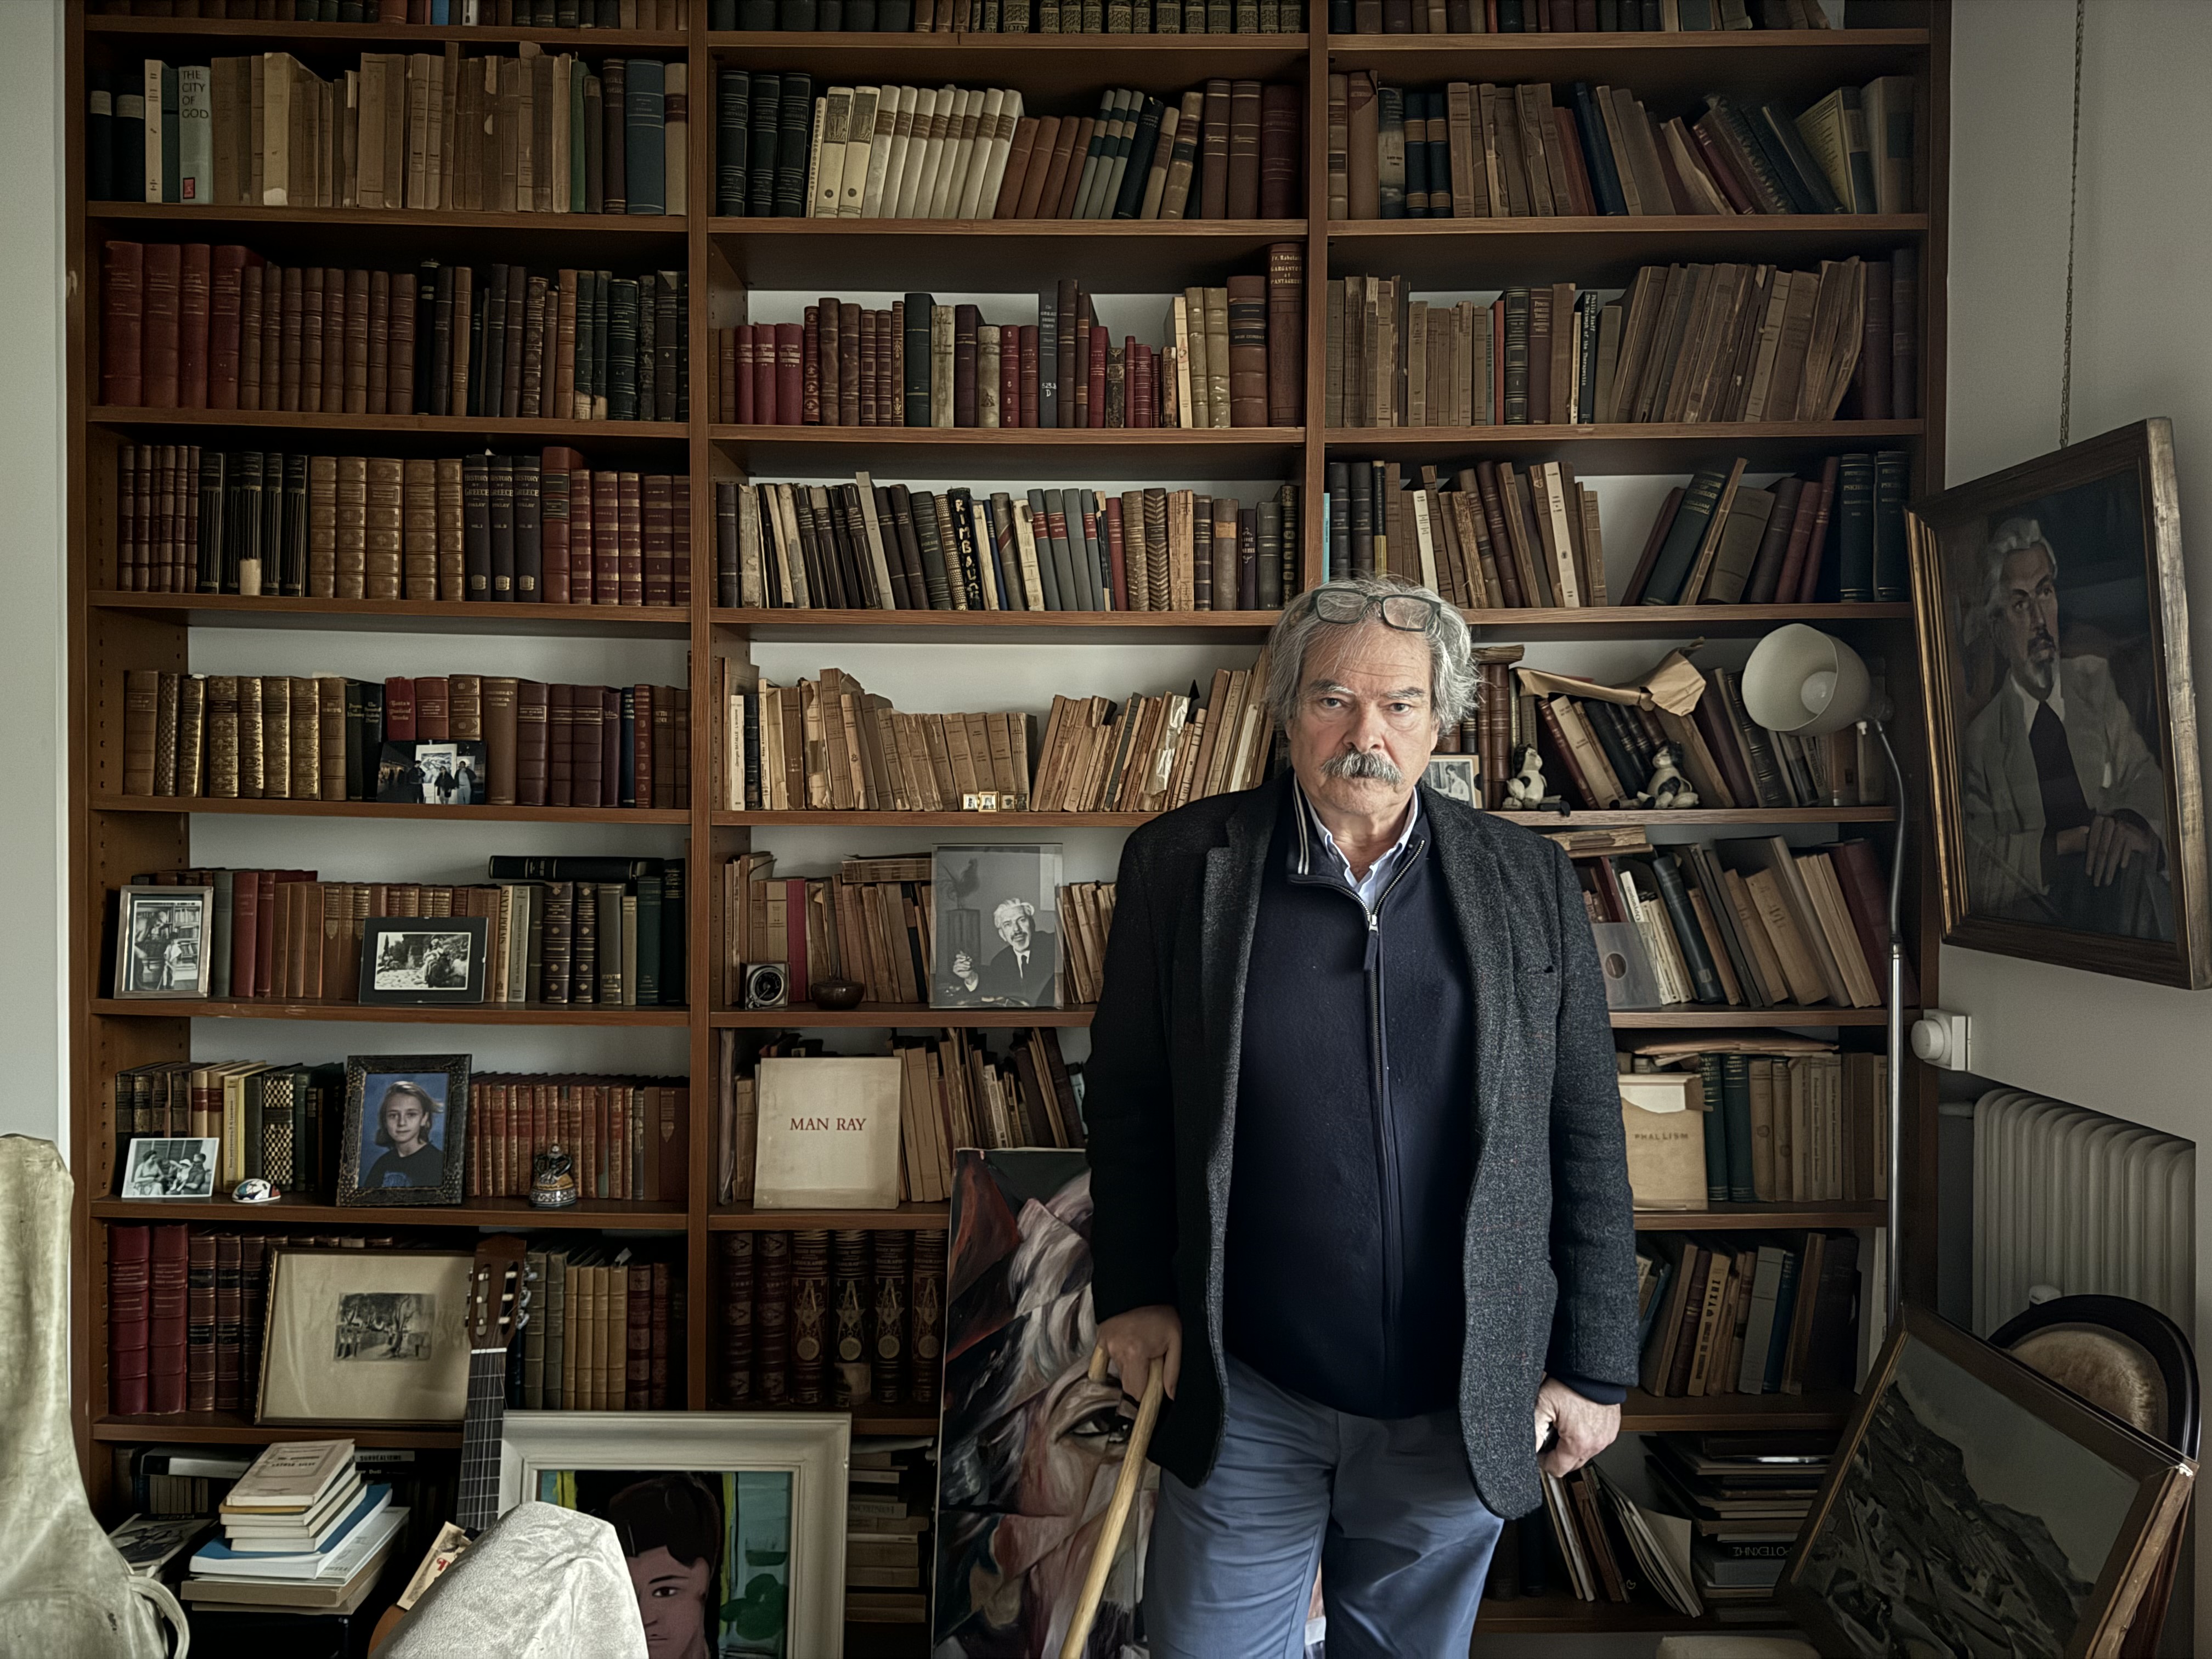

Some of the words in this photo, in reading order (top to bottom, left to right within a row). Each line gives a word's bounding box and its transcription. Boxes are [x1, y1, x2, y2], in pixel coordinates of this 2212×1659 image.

[183, 70, 201, 80] THE
[182, 82, 206, 93] CITY
[182, 95, 195, 105] OF
[182, 109, 209, 119] GOD
[465, 488, 489, 496] GREECE
[500, 889, 510, 916] SIXTY
[499, 917, 508, 945] POEMS
[790, 1118, 830, 1131] MAN
[836, 1118, 867, 1131] RAY
[1634, 1132, 1689, 1141] PHALLISM
